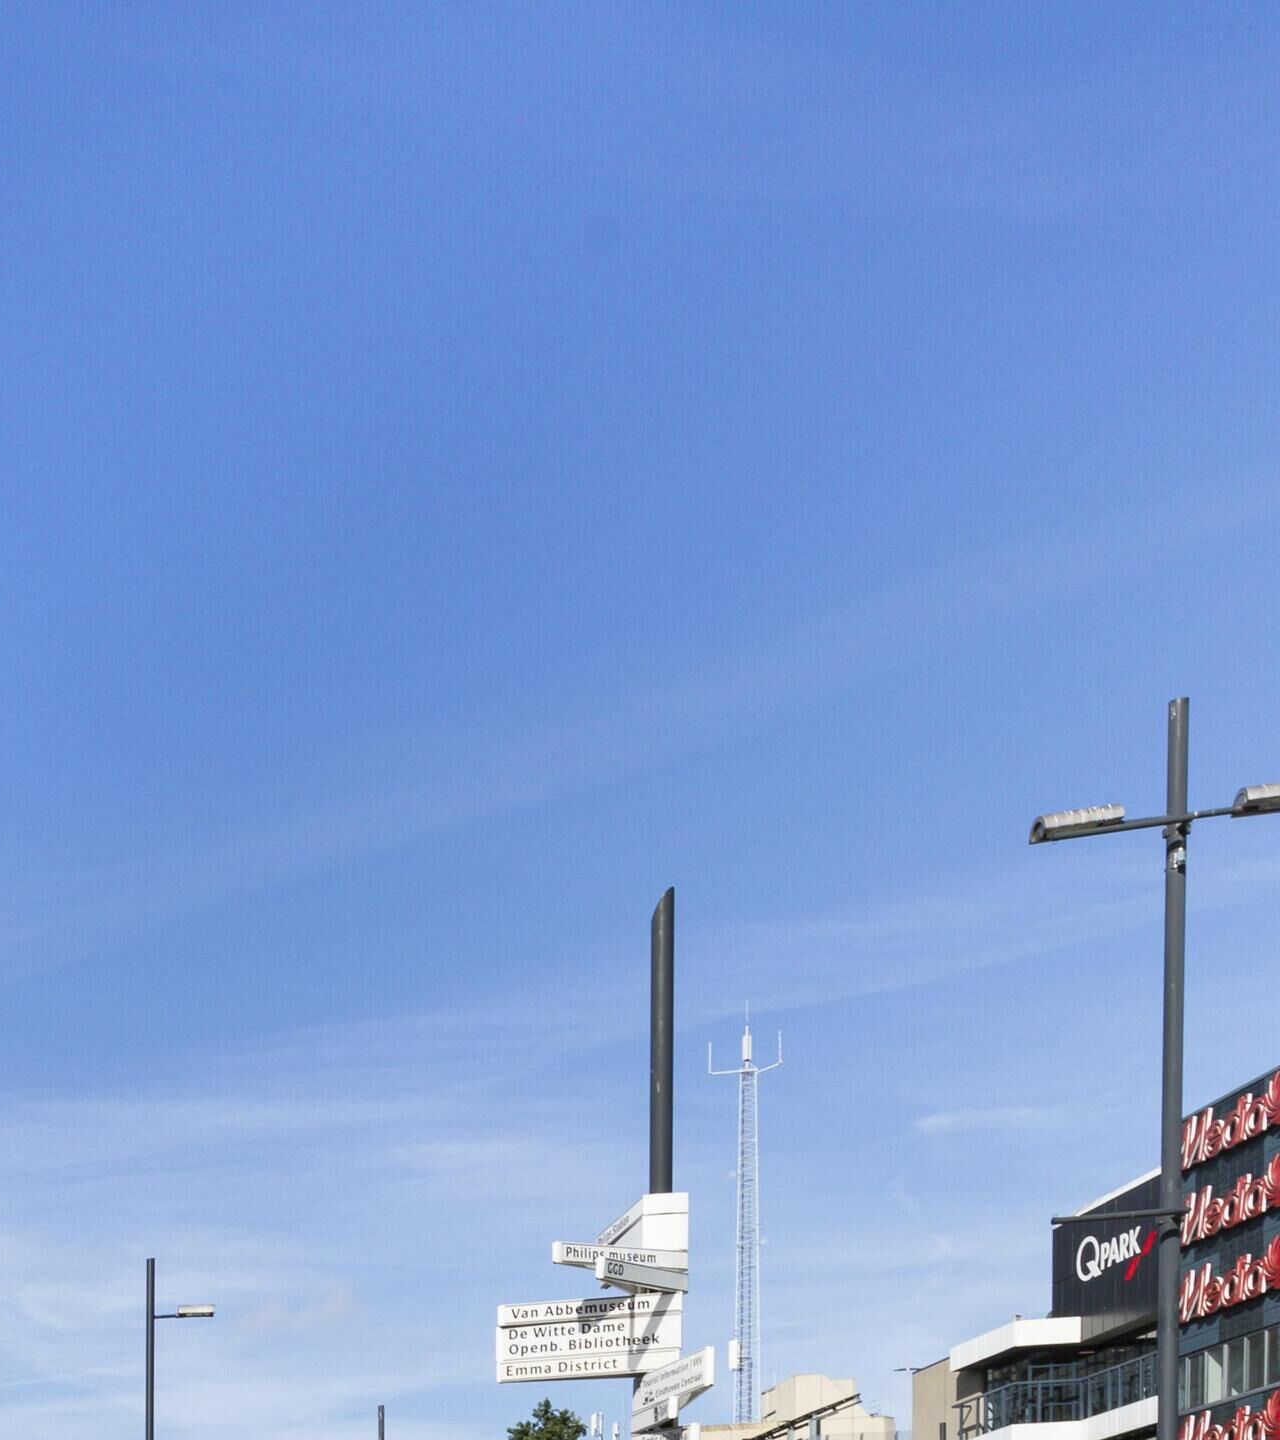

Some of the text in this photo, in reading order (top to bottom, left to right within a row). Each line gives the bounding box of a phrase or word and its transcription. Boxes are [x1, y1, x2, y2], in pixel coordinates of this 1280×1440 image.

[566, 1246, 657, 1263] Philips museum
[608, 1262, 624, 1276] GGD
[511, 1299, 650, 1319] Van Abbemuseum
[509, 1321, 625, 1340] De Witte Dame
[509, 1333, 660, 1356] Openb. Bibliotheek
[506, 1358, 618, 1377] Emma District
